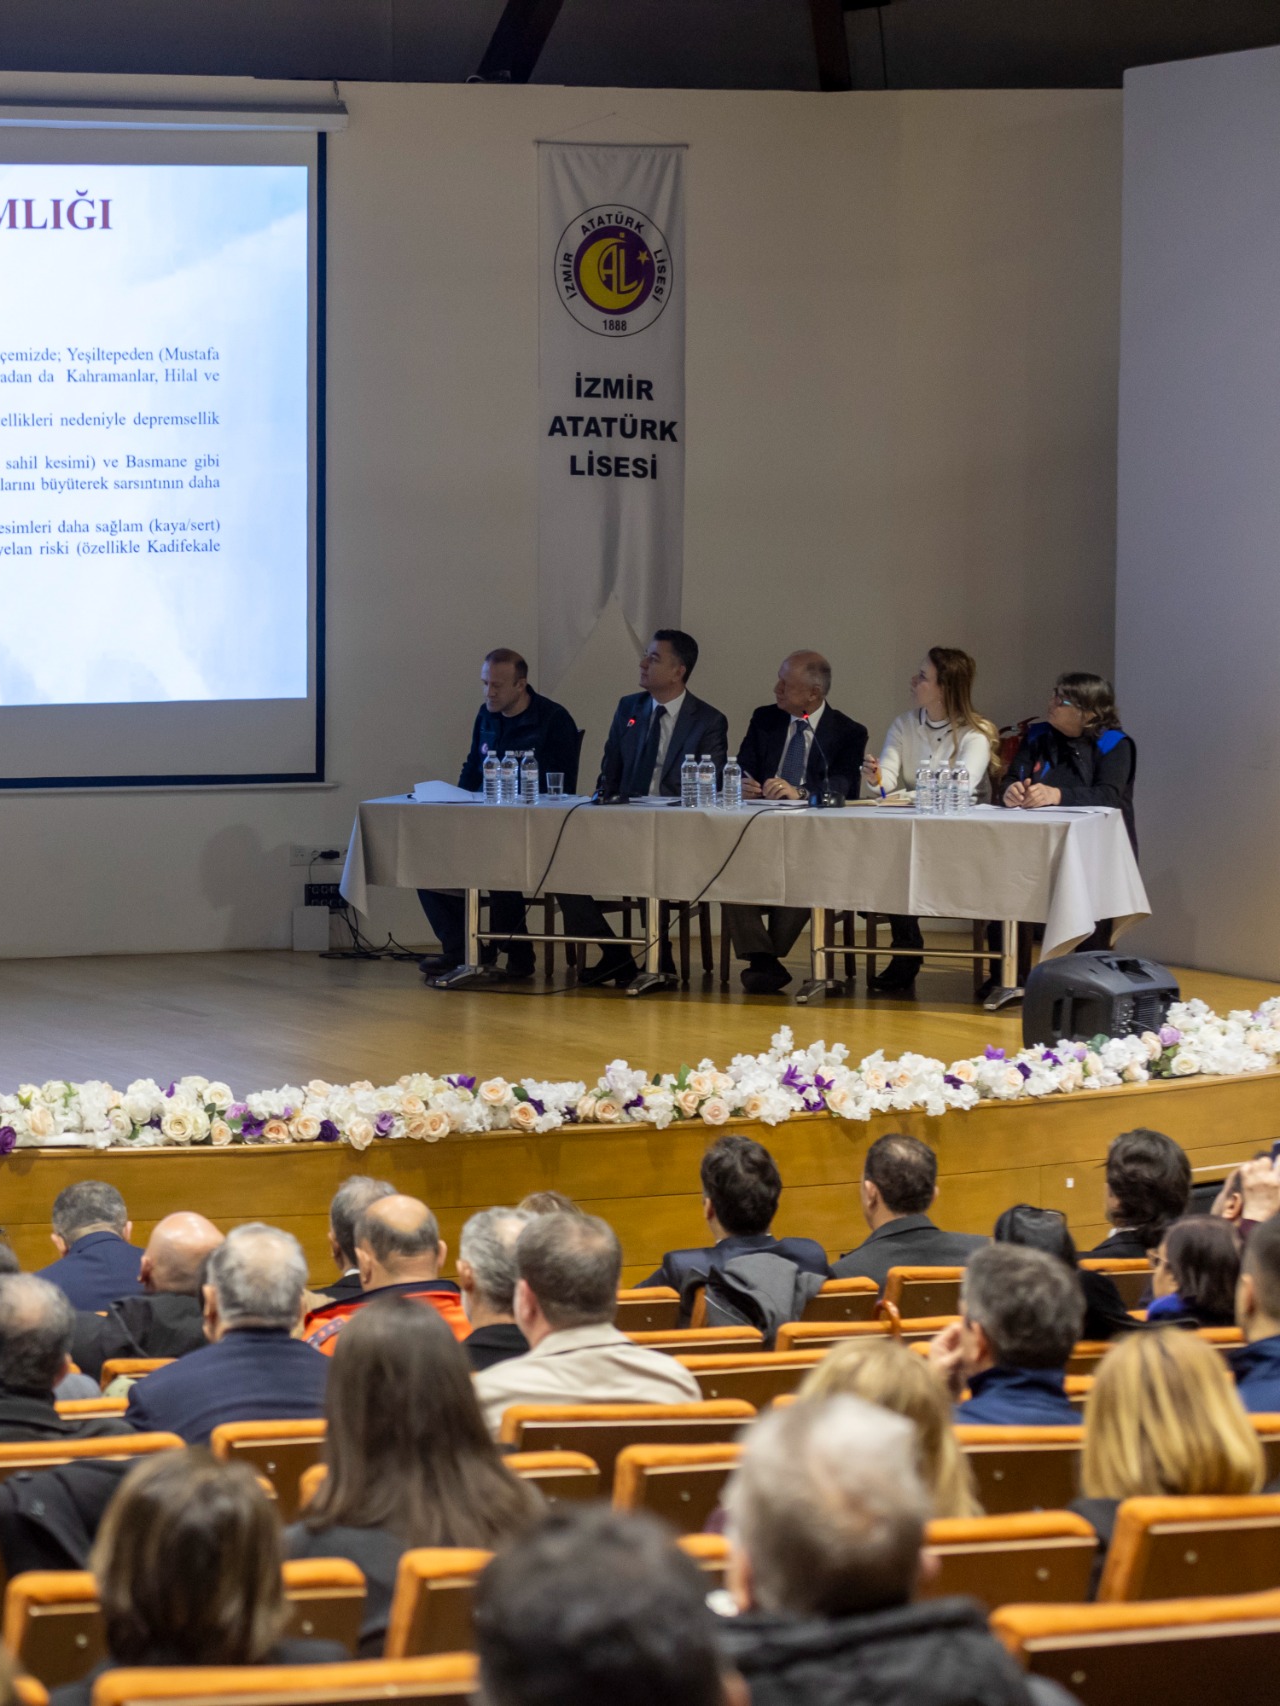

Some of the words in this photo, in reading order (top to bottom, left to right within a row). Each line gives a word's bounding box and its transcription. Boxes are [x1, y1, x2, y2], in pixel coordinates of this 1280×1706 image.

[581, 211, 645, 236] ATATÜRK
[560, 252, 578, 300] İZMİR
[653, 249, 668, 303] LİSESİ
[602, 319, 627, 331] 1888
[66, 346, 154, 366] Yeşiltepeden
[158, 346, 220, 363] (Mustafa
[37, 368, 55, 384] da
[66, 367, 159, 384] Kahramanlar,
[164, 367, 198, 383] Hilal
[203, 371, 220, 382] ve
[575, 372, 654, 401] İZMİR
[60, 411, 127, 430] nedeniyle
[132, 410, 220, 430] depremsellik
[548, 413, 678, 442] ATATÜRK
[5, 455, 38, 471] sahil
[45, 454, 96, 471] kesimi)
[102, 458, 119, 469] ve
[125, 453, 188, 469] Basmane
[194, 453, 220, 472] gibi
[570, 450, 657, 480] LİSESİ
[40, 475, 109, 495] büyüterek
[113, 477, 184, 491] sarsıntının
[188, 474, 221, 489] daha
[57, 518, 90, 535] daha
[95, 517, 144, 538] sağlam
[148, 516, 221, 536] (kaya/sert)
[39, 540, 70, 556] riski
[76, 539, 141, 558] (özellikle
[147, 537, 221, 554] Kadifekale
